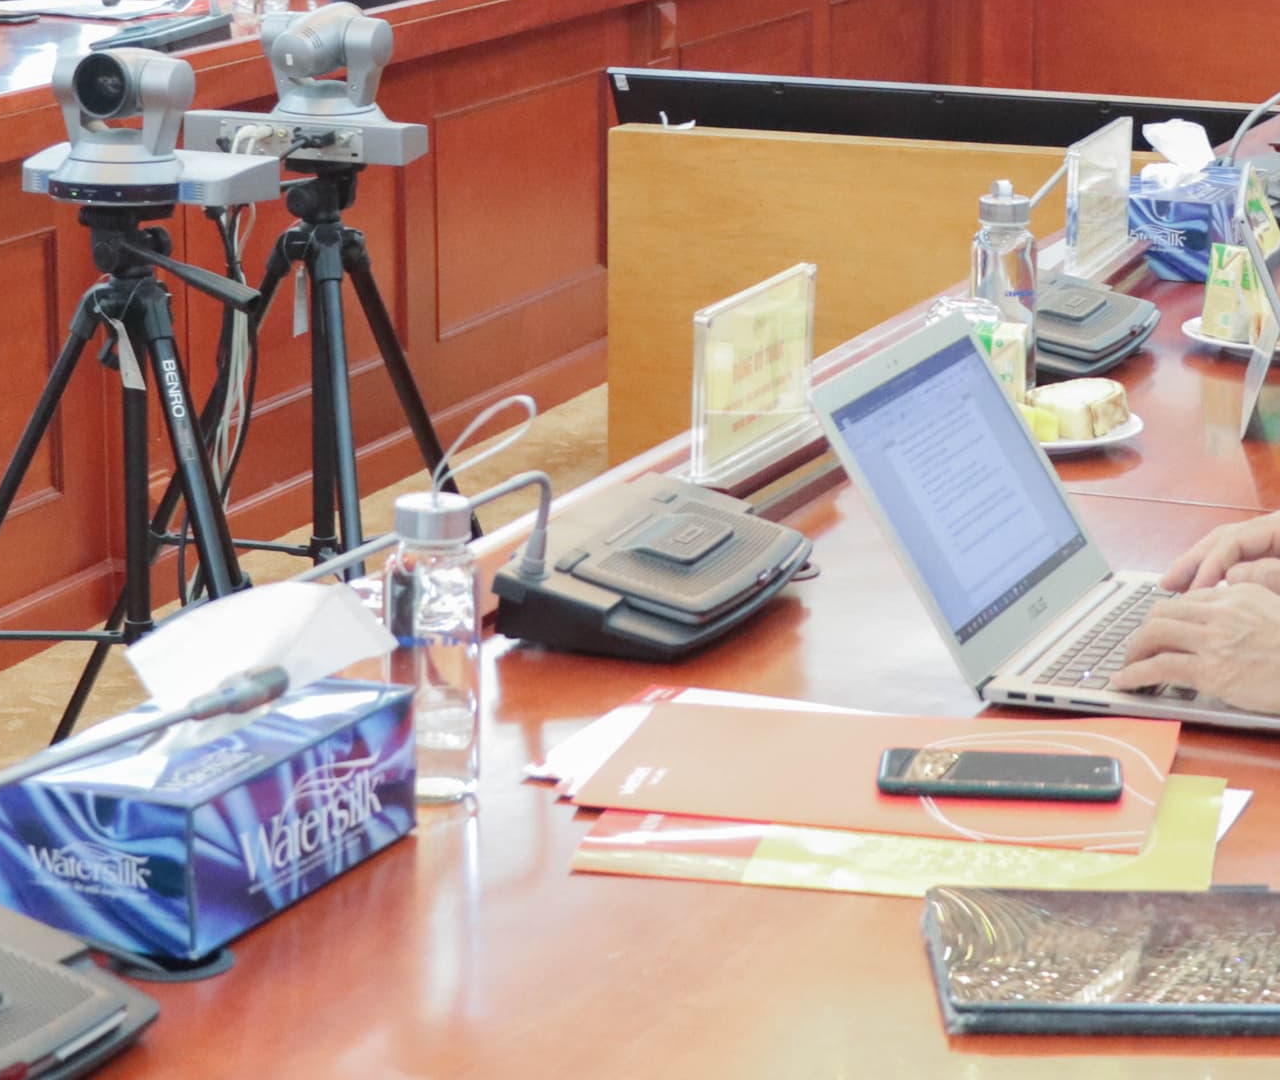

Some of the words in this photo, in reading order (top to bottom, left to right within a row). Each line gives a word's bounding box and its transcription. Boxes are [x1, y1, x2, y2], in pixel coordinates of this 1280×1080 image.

[162, 359, 186, 419] BENRO
[240, 765, 383, 880] Watersilk
[27, 844, 151, 890] Watersilk
